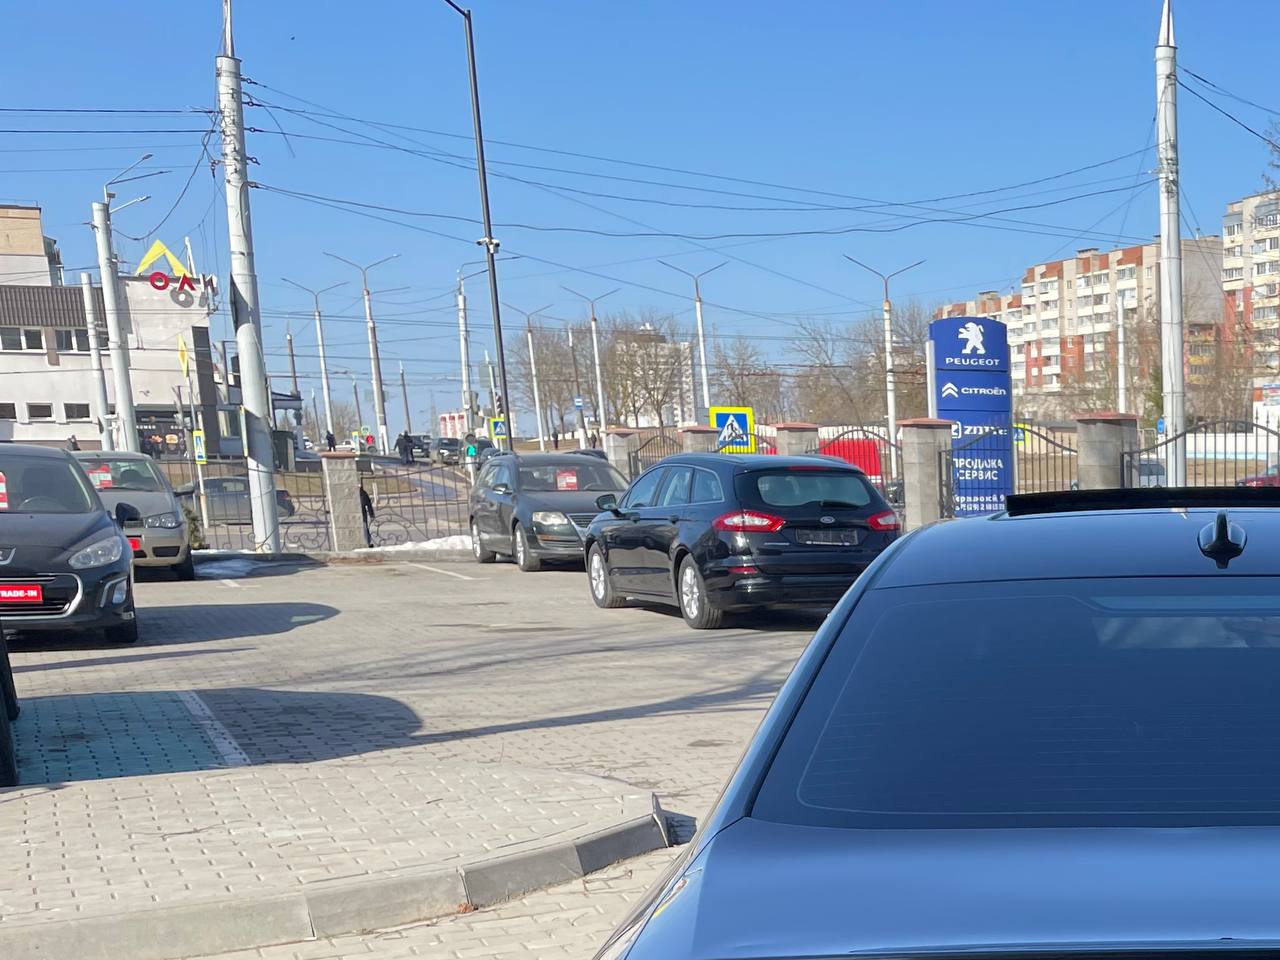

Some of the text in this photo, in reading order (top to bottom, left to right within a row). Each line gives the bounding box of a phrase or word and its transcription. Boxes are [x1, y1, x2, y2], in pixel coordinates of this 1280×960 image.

[945, 357, 1000, 366] PEUGEOT
[956, 470, 999, 480] СЕРВИС
[0, 590, 38, 598] RADE-IN
